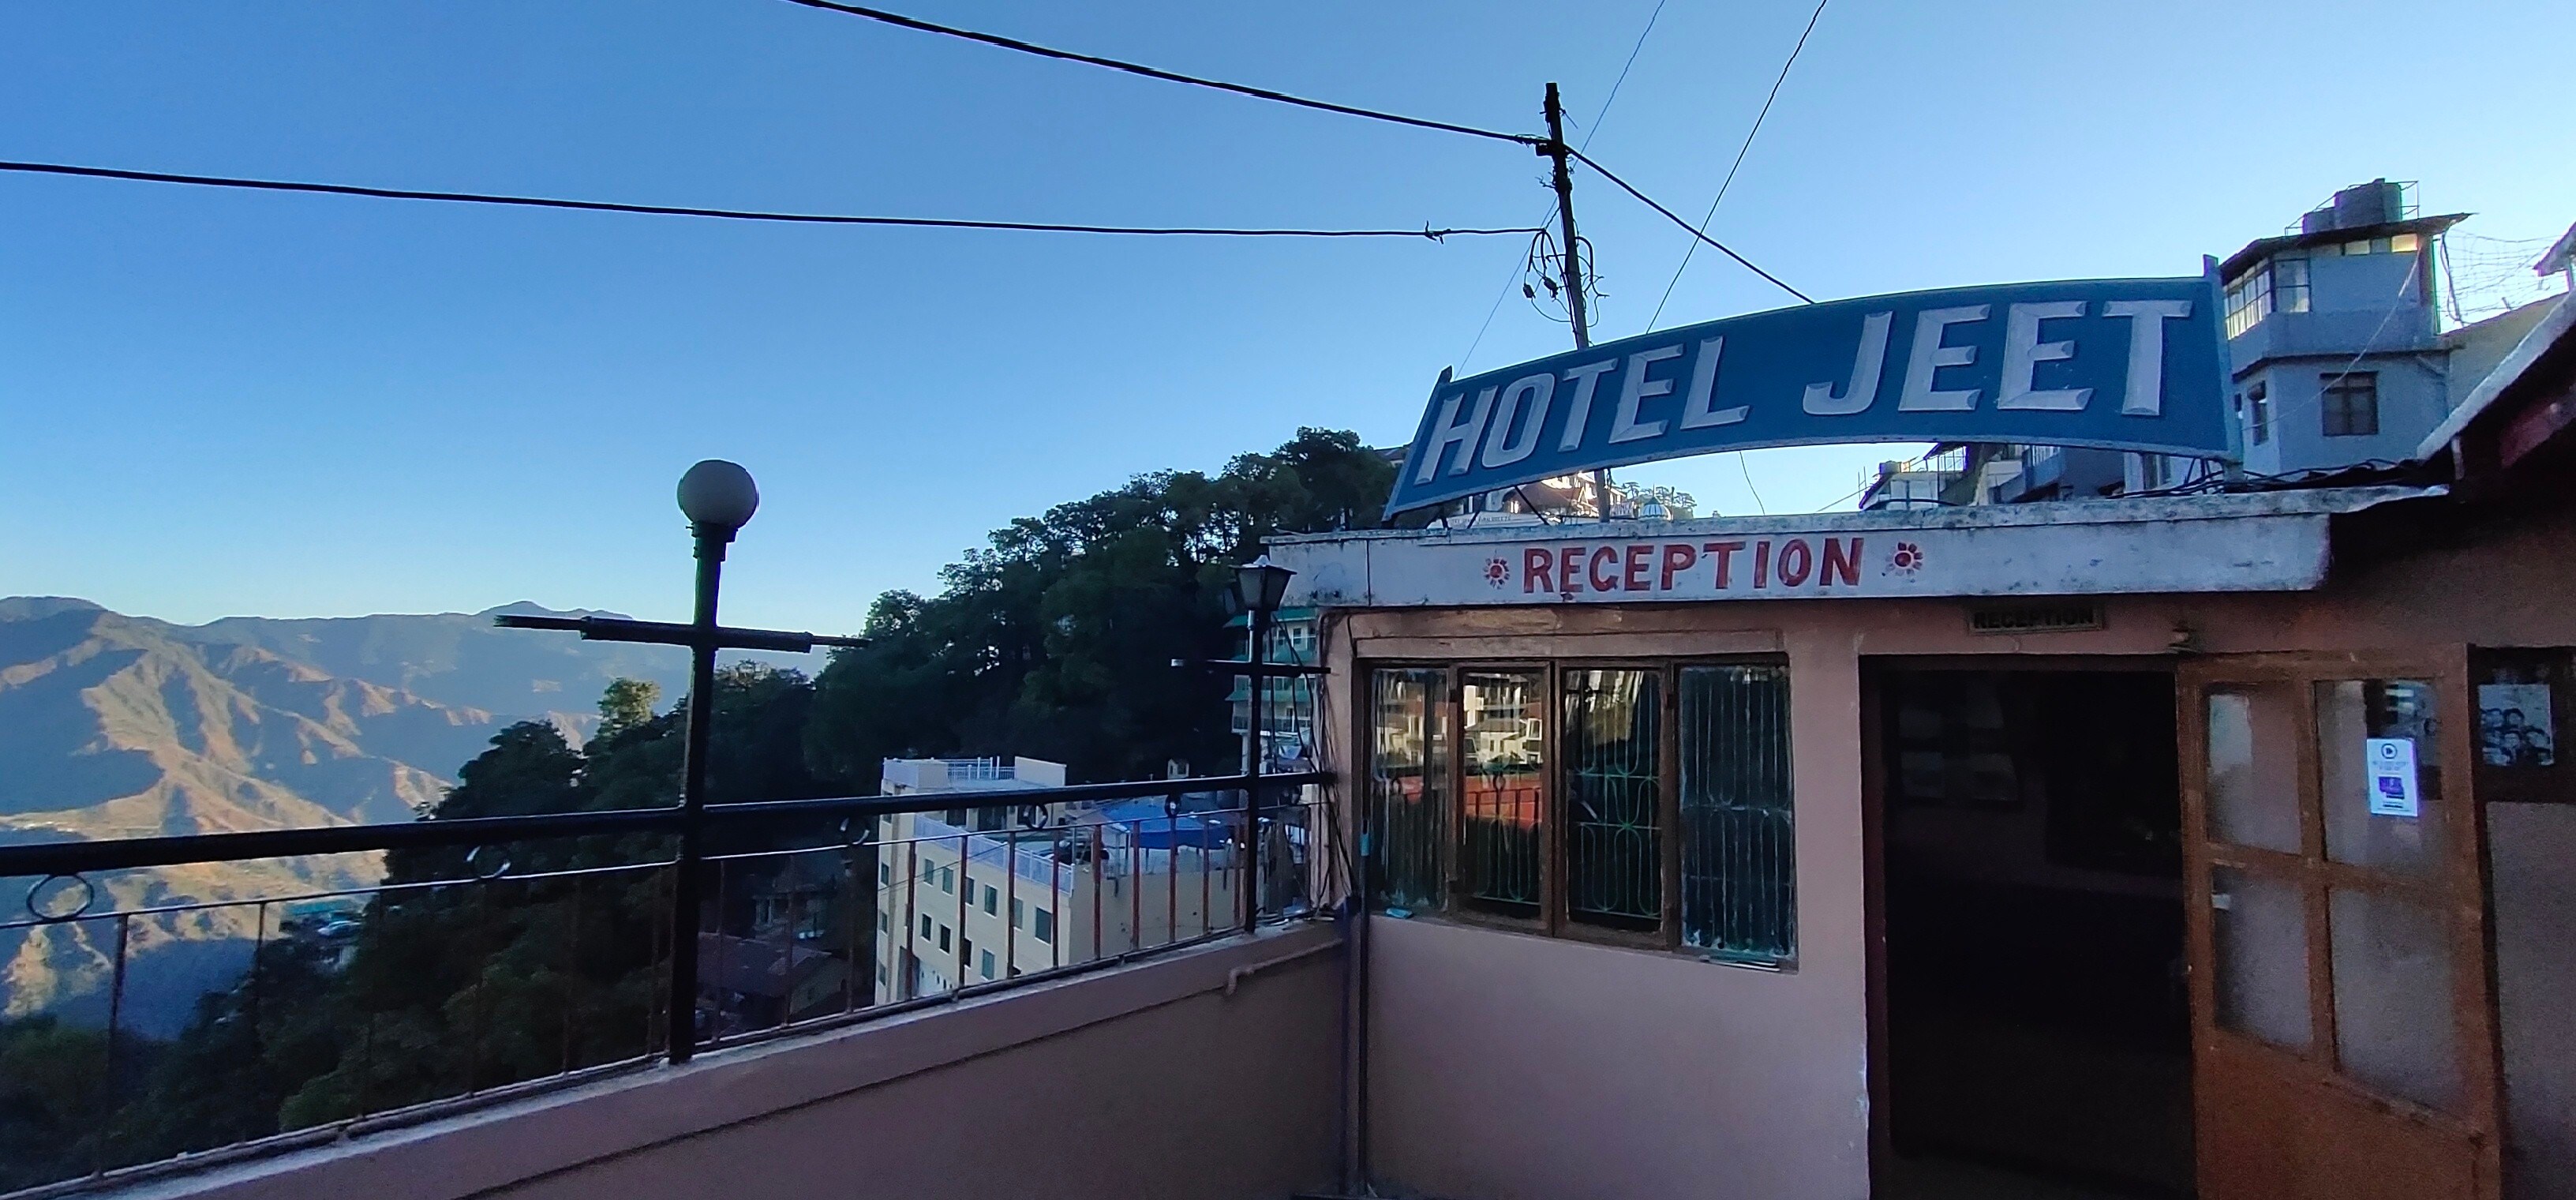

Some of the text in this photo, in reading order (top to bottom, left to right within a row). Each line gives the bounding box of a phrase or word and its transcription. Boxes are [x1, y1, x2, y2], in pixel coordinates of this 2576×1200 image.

[1416, 299, 2192, 485] HOTEL JEET
[1523, 538, 1863, 594] RECEPTION
[1974, 608, 2095, 628] RECEPTION
